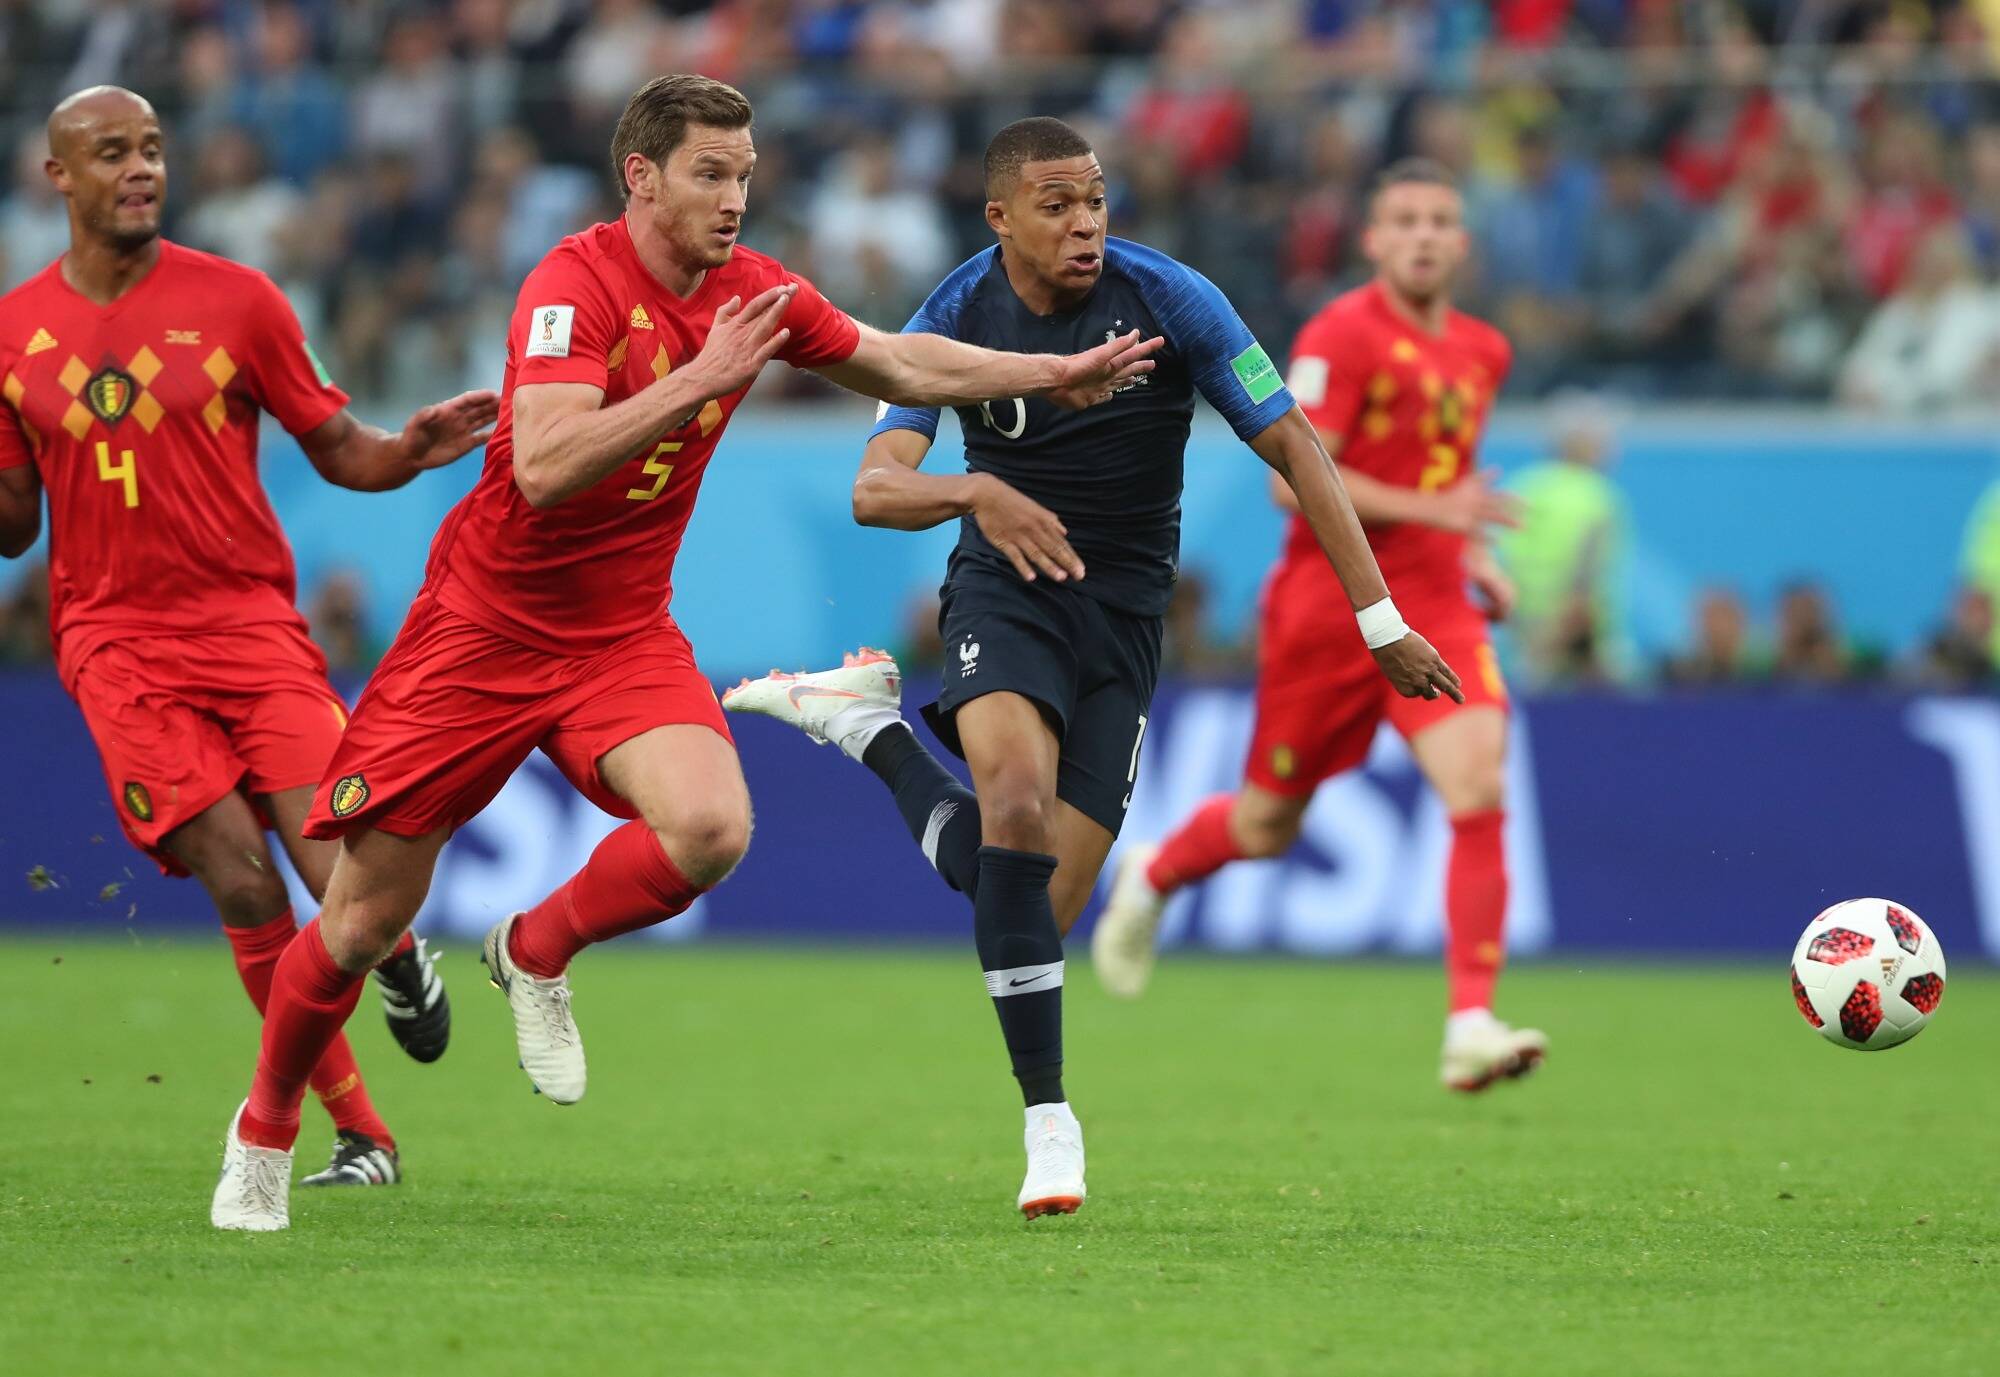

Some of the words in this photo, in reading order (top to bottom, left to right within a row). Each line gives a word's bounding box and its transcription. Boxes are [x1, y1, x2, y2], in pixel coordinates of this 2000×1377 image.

[95, 441, 139, 508] 4
[626, 442, 684, 501] 5
[1420, 444, 1459, 496] 2
